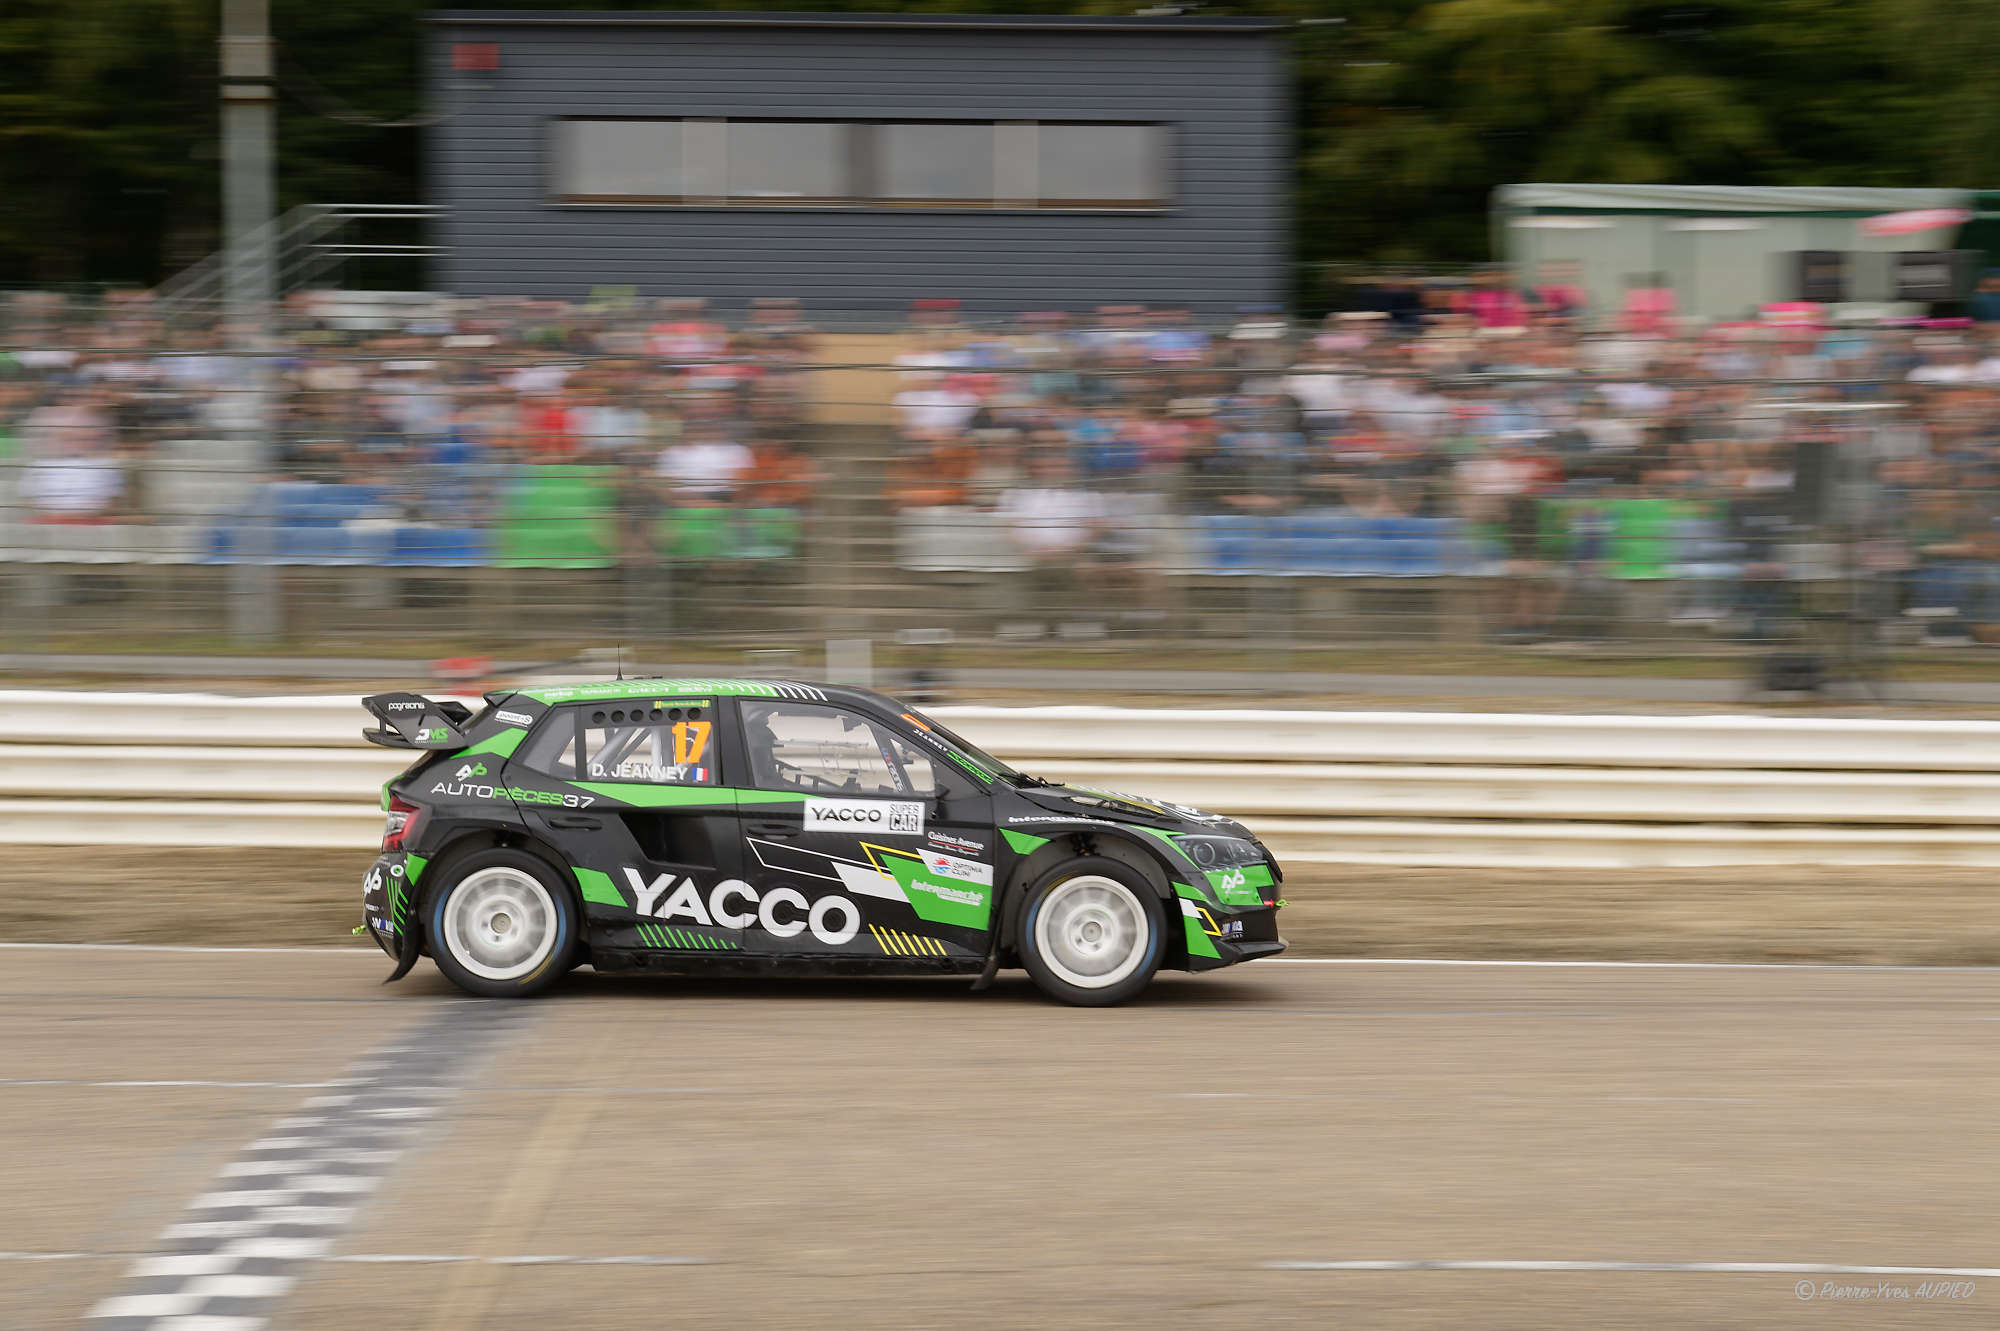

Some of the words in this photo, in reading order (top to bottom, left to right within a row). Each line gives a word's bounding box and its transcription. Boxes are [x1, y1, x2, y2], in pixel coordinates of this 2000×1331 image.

[672, 721, 711, 763] 17
[591, 763, 607, 777] D.
[611, 764, 688, 780] JEANNEY
[811, 807, 881, 822] YACCO
[890, 814, 918, 831] CAR
[622, 867, 861, 945] YACCO
